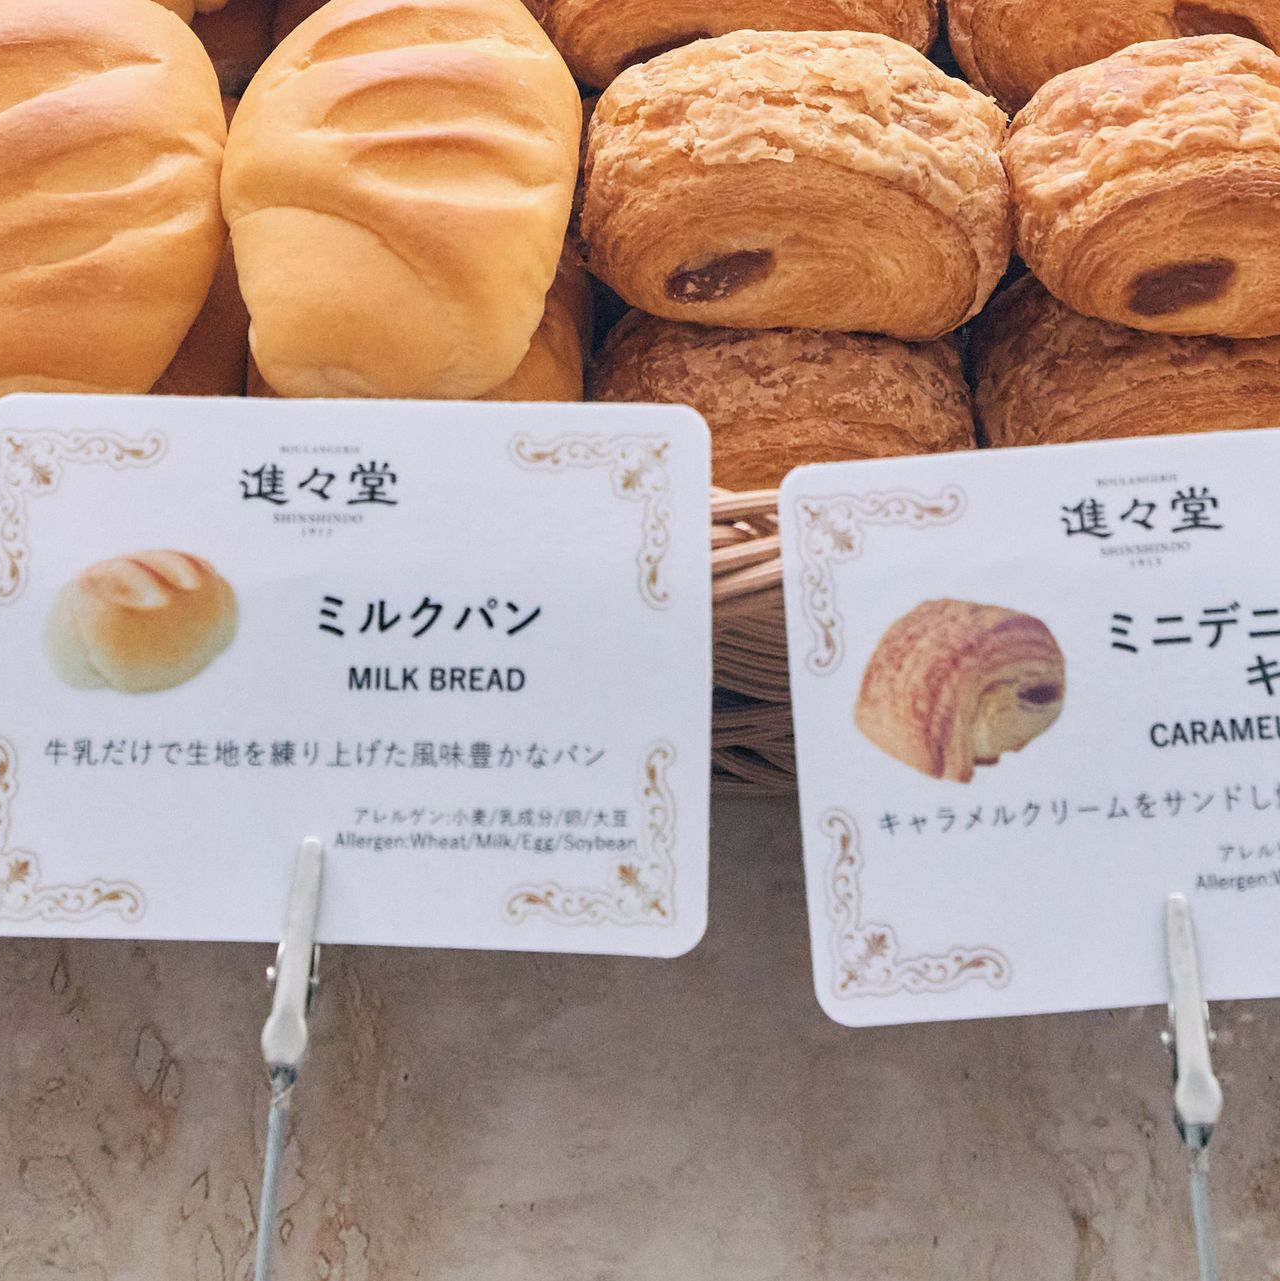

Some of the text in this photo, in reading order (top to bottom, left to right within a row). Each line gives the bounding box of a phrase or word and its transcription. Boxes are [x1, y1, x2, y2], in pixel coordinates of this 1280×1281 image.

[239, 460, 398, 507] 進々堂
[1060, 487, 1224, 540] 進々堂
[318, 595, 542, 639] ミルクパン
[348, 666, 526, 693] MILK BREAD
